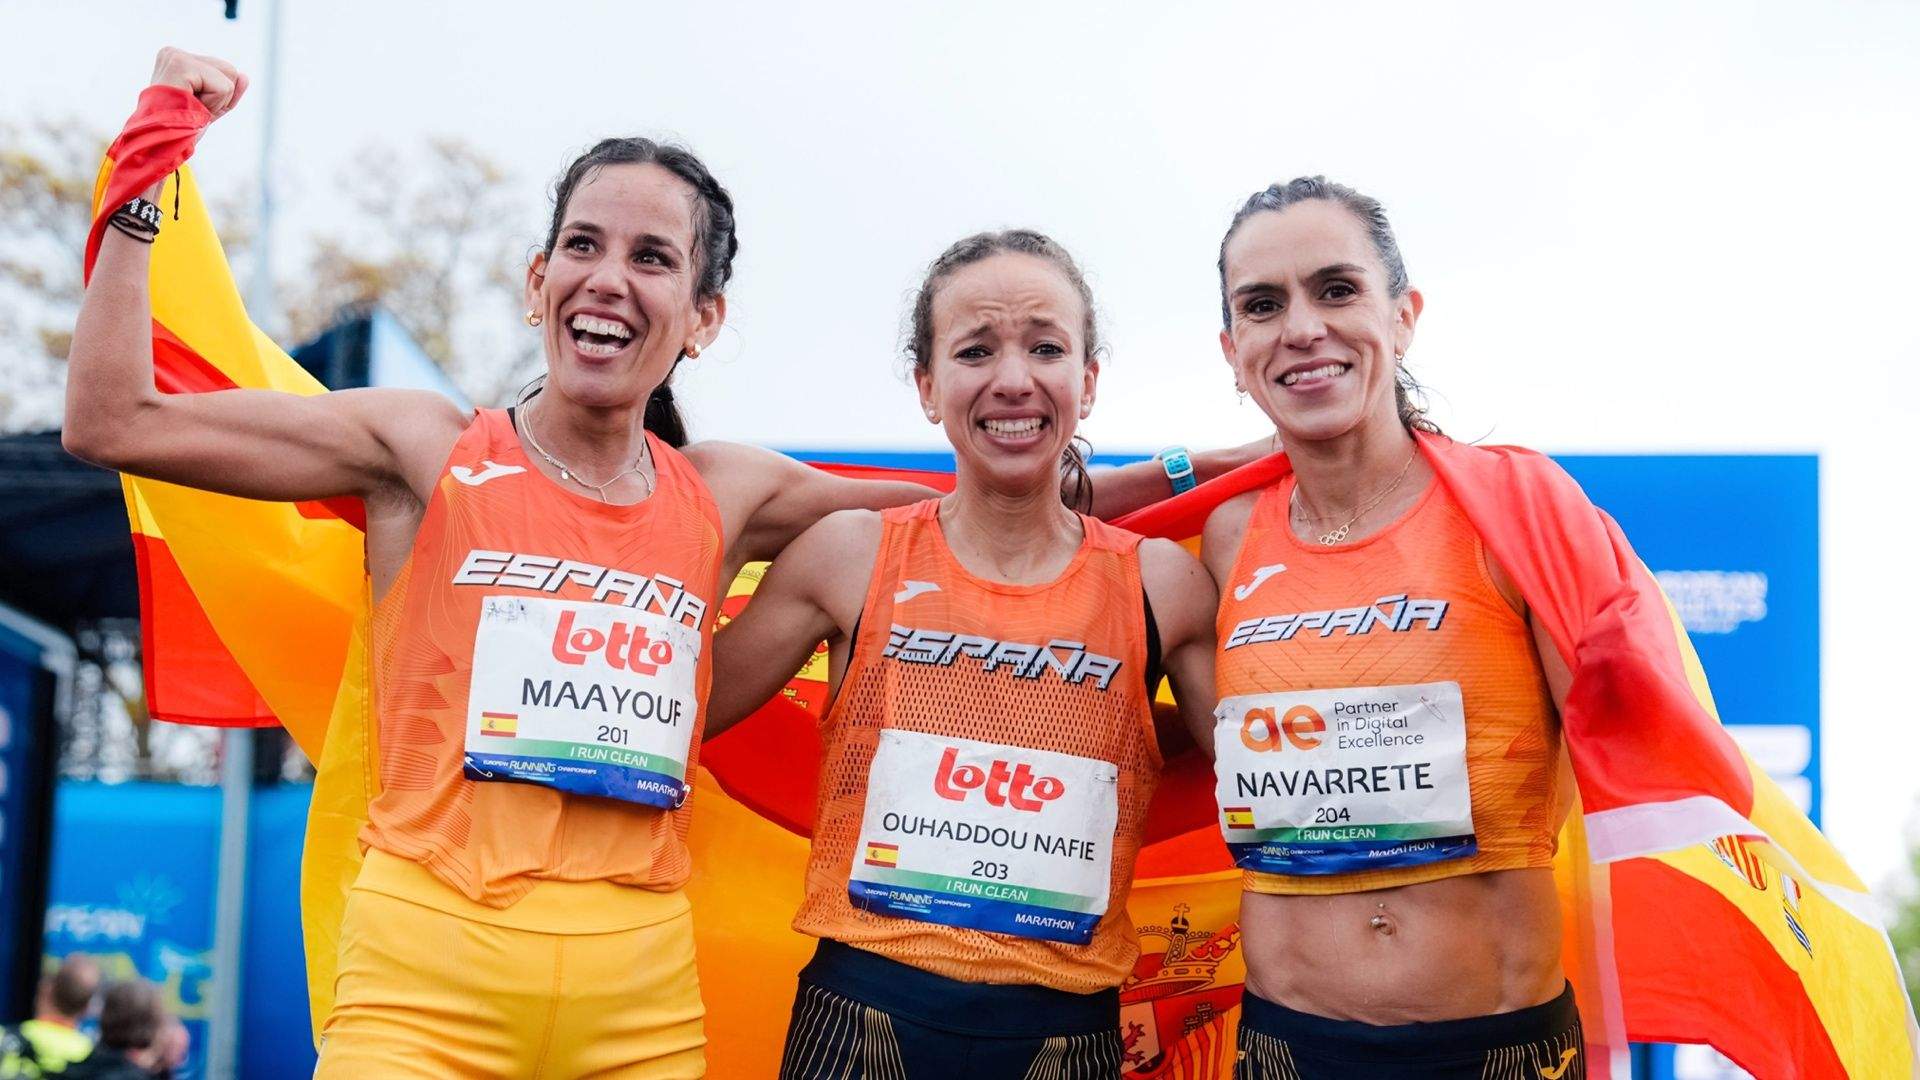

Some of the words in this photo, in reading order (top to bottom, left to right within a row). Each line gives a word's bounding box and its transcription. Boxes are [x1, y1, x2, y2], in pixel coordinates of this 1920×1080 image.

[452, 549, 707, 631] ESPAÑA
[1225, 594, 1449, 651] ESPAÑA
[882, 623, 1122, 691] ESPAÑA
[521, 678, 681, 726] MAAYOUF
[1334, 701, 1399, 715] Partner
[1240, 704, 1326, 752] ae
[1337, 718, 1350, 731] in
[1355, 715, 1409, 734] Digital
[596, 726, 628, 745] 201
[1338, 731, 1424, 750] Excellence
[509, 760, 557, 773] RUNNING
[570, 747, 575, 757] I
[577, 748, 607, 760] RUN
[611, 751, 648, 767] CLEAN
[637, 780, 679, 798] MARATHON
[1236, 762, 1434, 797] NAVARRETE
[1314, 807, 1351, 823] 204
[882, 812, 1027, 850] OUHADDOU
[1034, 835, 1096, 861] NAFIE
[1304, 829, 1330, 840] RUN
[1333, 827, 1376, 840] CLEAN
[971, 860, 1009, 880] 203
[889, 891, 933, 905] RUNNING
[946, 880, 952, 890] I
[953, 881, 983, 895] RUN
[985, 885, 1028, 901] CLEAN
[1015, 914, 1075, 930] MARATHON
